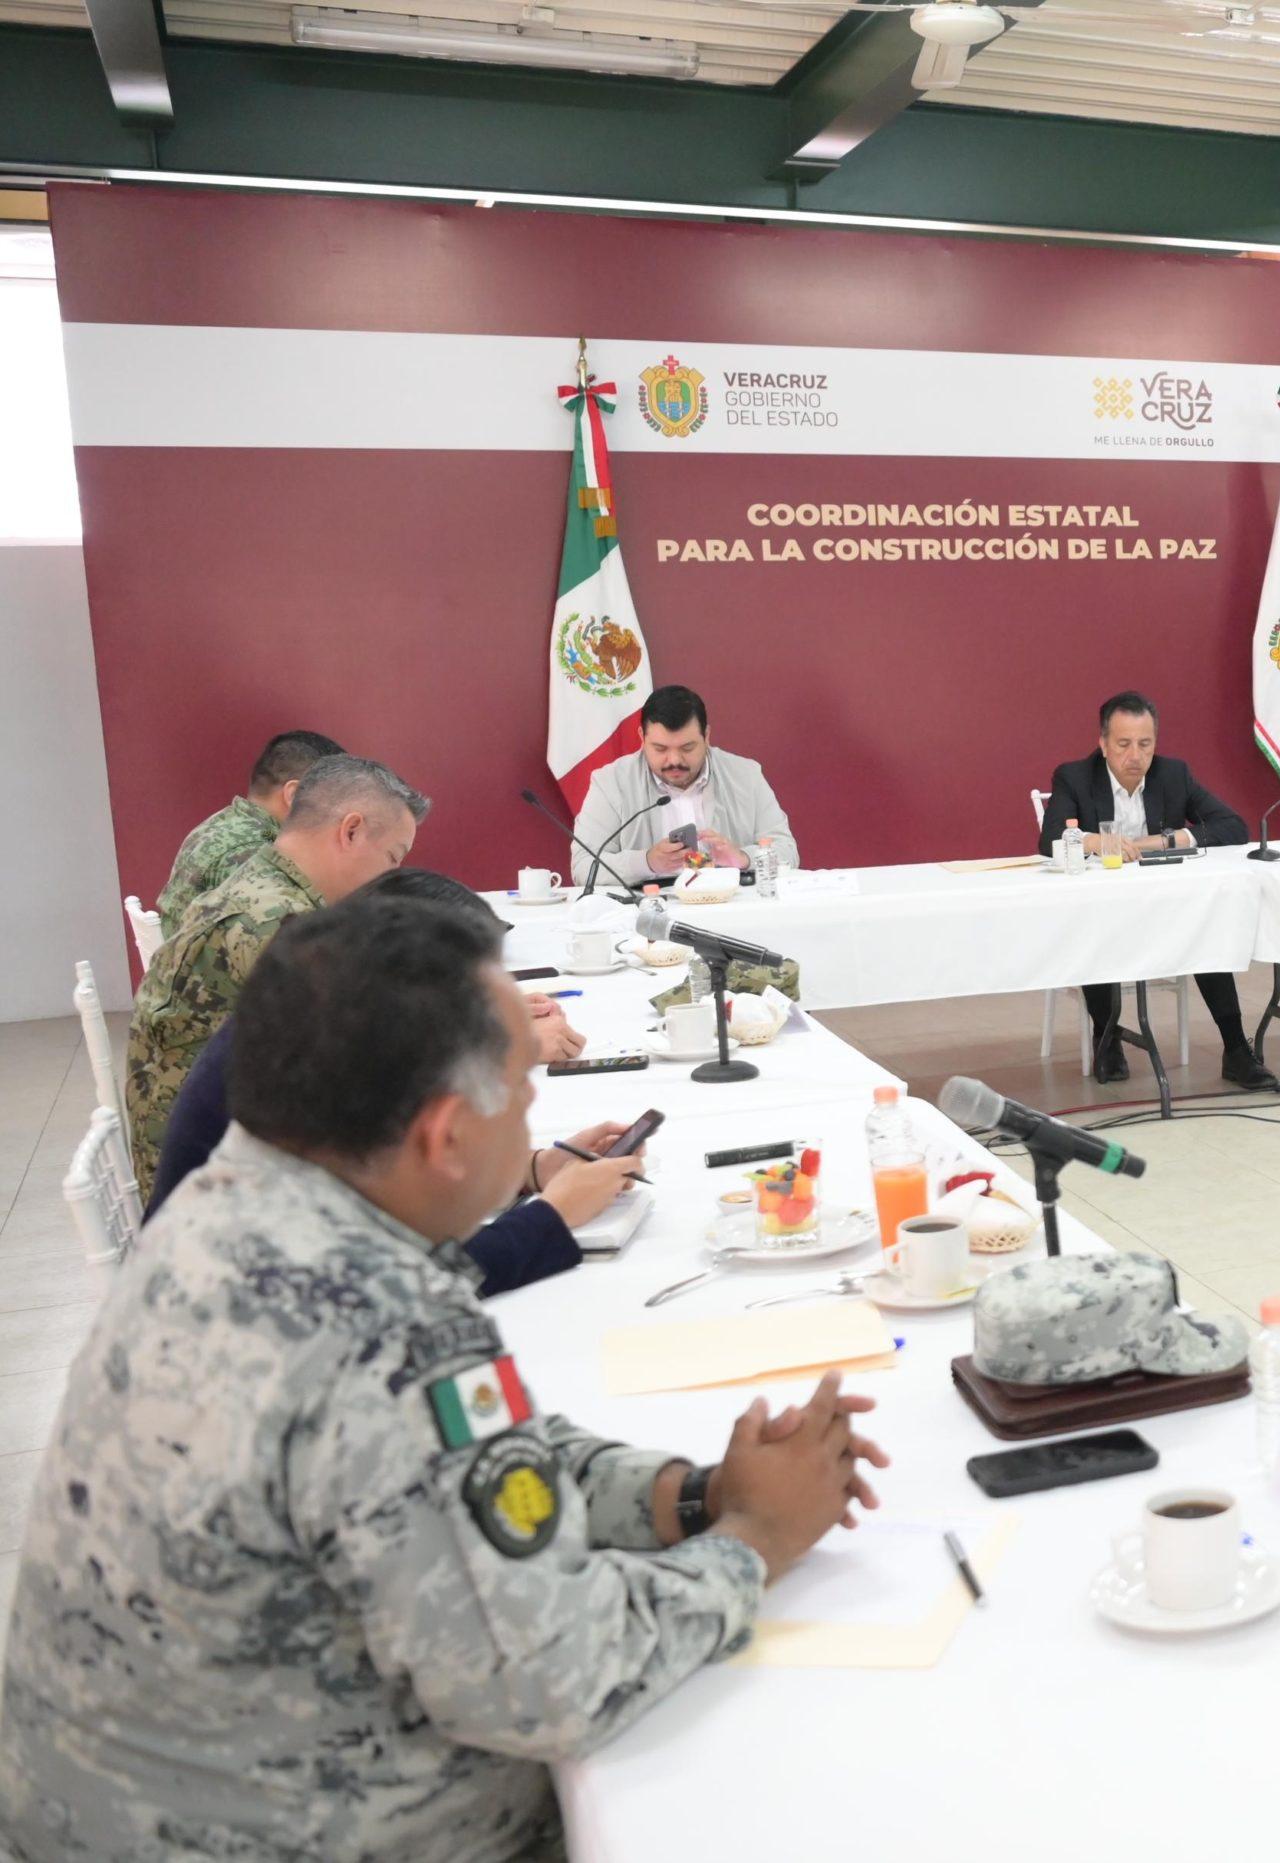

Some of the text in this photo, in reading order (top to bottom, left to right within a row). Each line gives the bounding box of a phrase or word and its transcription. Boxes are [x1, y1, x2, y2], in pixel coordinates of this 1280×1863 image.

[723, 372, 828, 389] VERACRUZ
[1140, 371, 1212, 401] VERA
[725, 391, 821, 408] GOBIERNO
[727, 410, 839, 427] DEL ESTADO
[1141, 401, 1212, 430] CRUZ
[1094, 436, 1214, 447] ME LLENA DE ORGULLO
[747, 499, 1139, 527] COORDINACIÓN ESTATAL
[657, 532, 1218, 562] PARA LA CONSTRUCCIÓN DE LA PAZ
